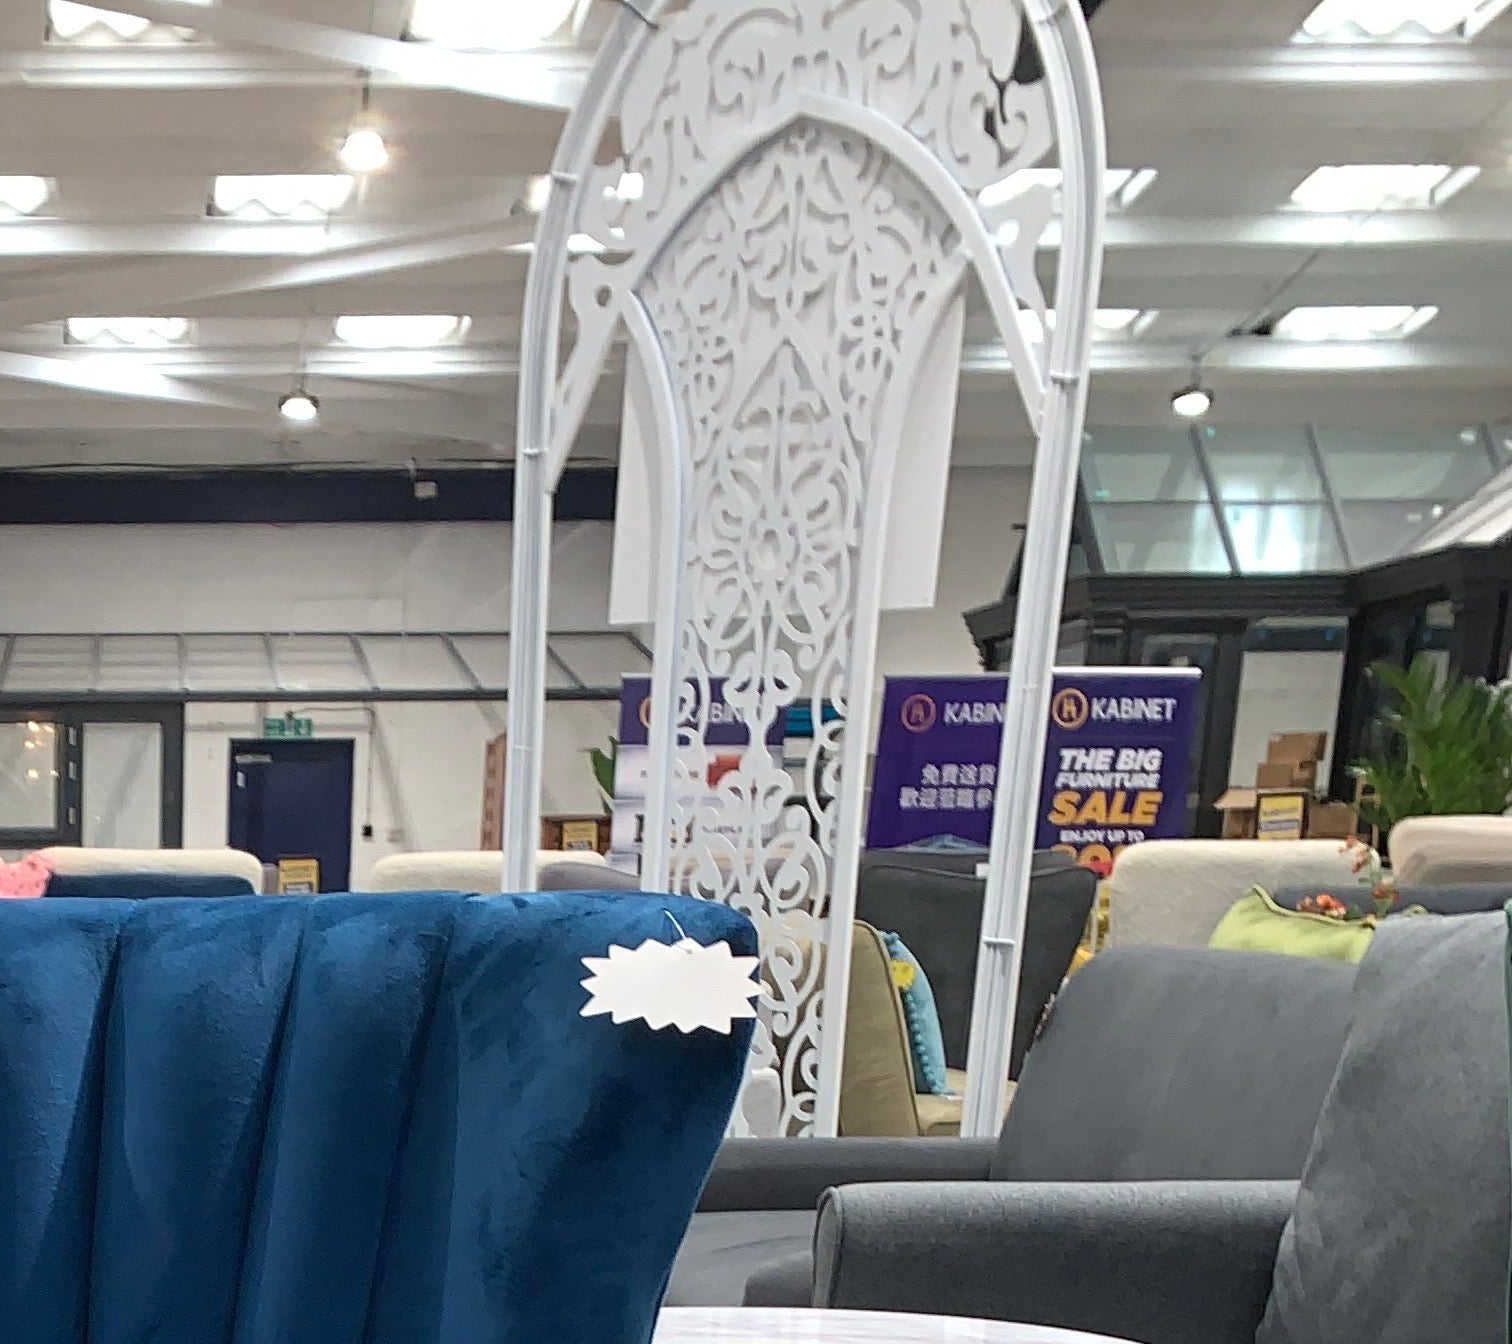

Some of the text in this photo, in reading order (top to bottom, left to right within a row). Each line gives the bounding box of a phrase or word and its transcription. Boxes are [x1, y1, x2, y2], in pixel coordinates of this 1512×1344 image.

[1091, 698, 1177, 722] KABINET
[1059, 748, 1163, 771] THE BIG
[1055, 771, 1161, 789] FURNITURE
[1048, 790, 1163, 826] SALE
[1059, 830, 1145, 843] ENJOY UP TO
